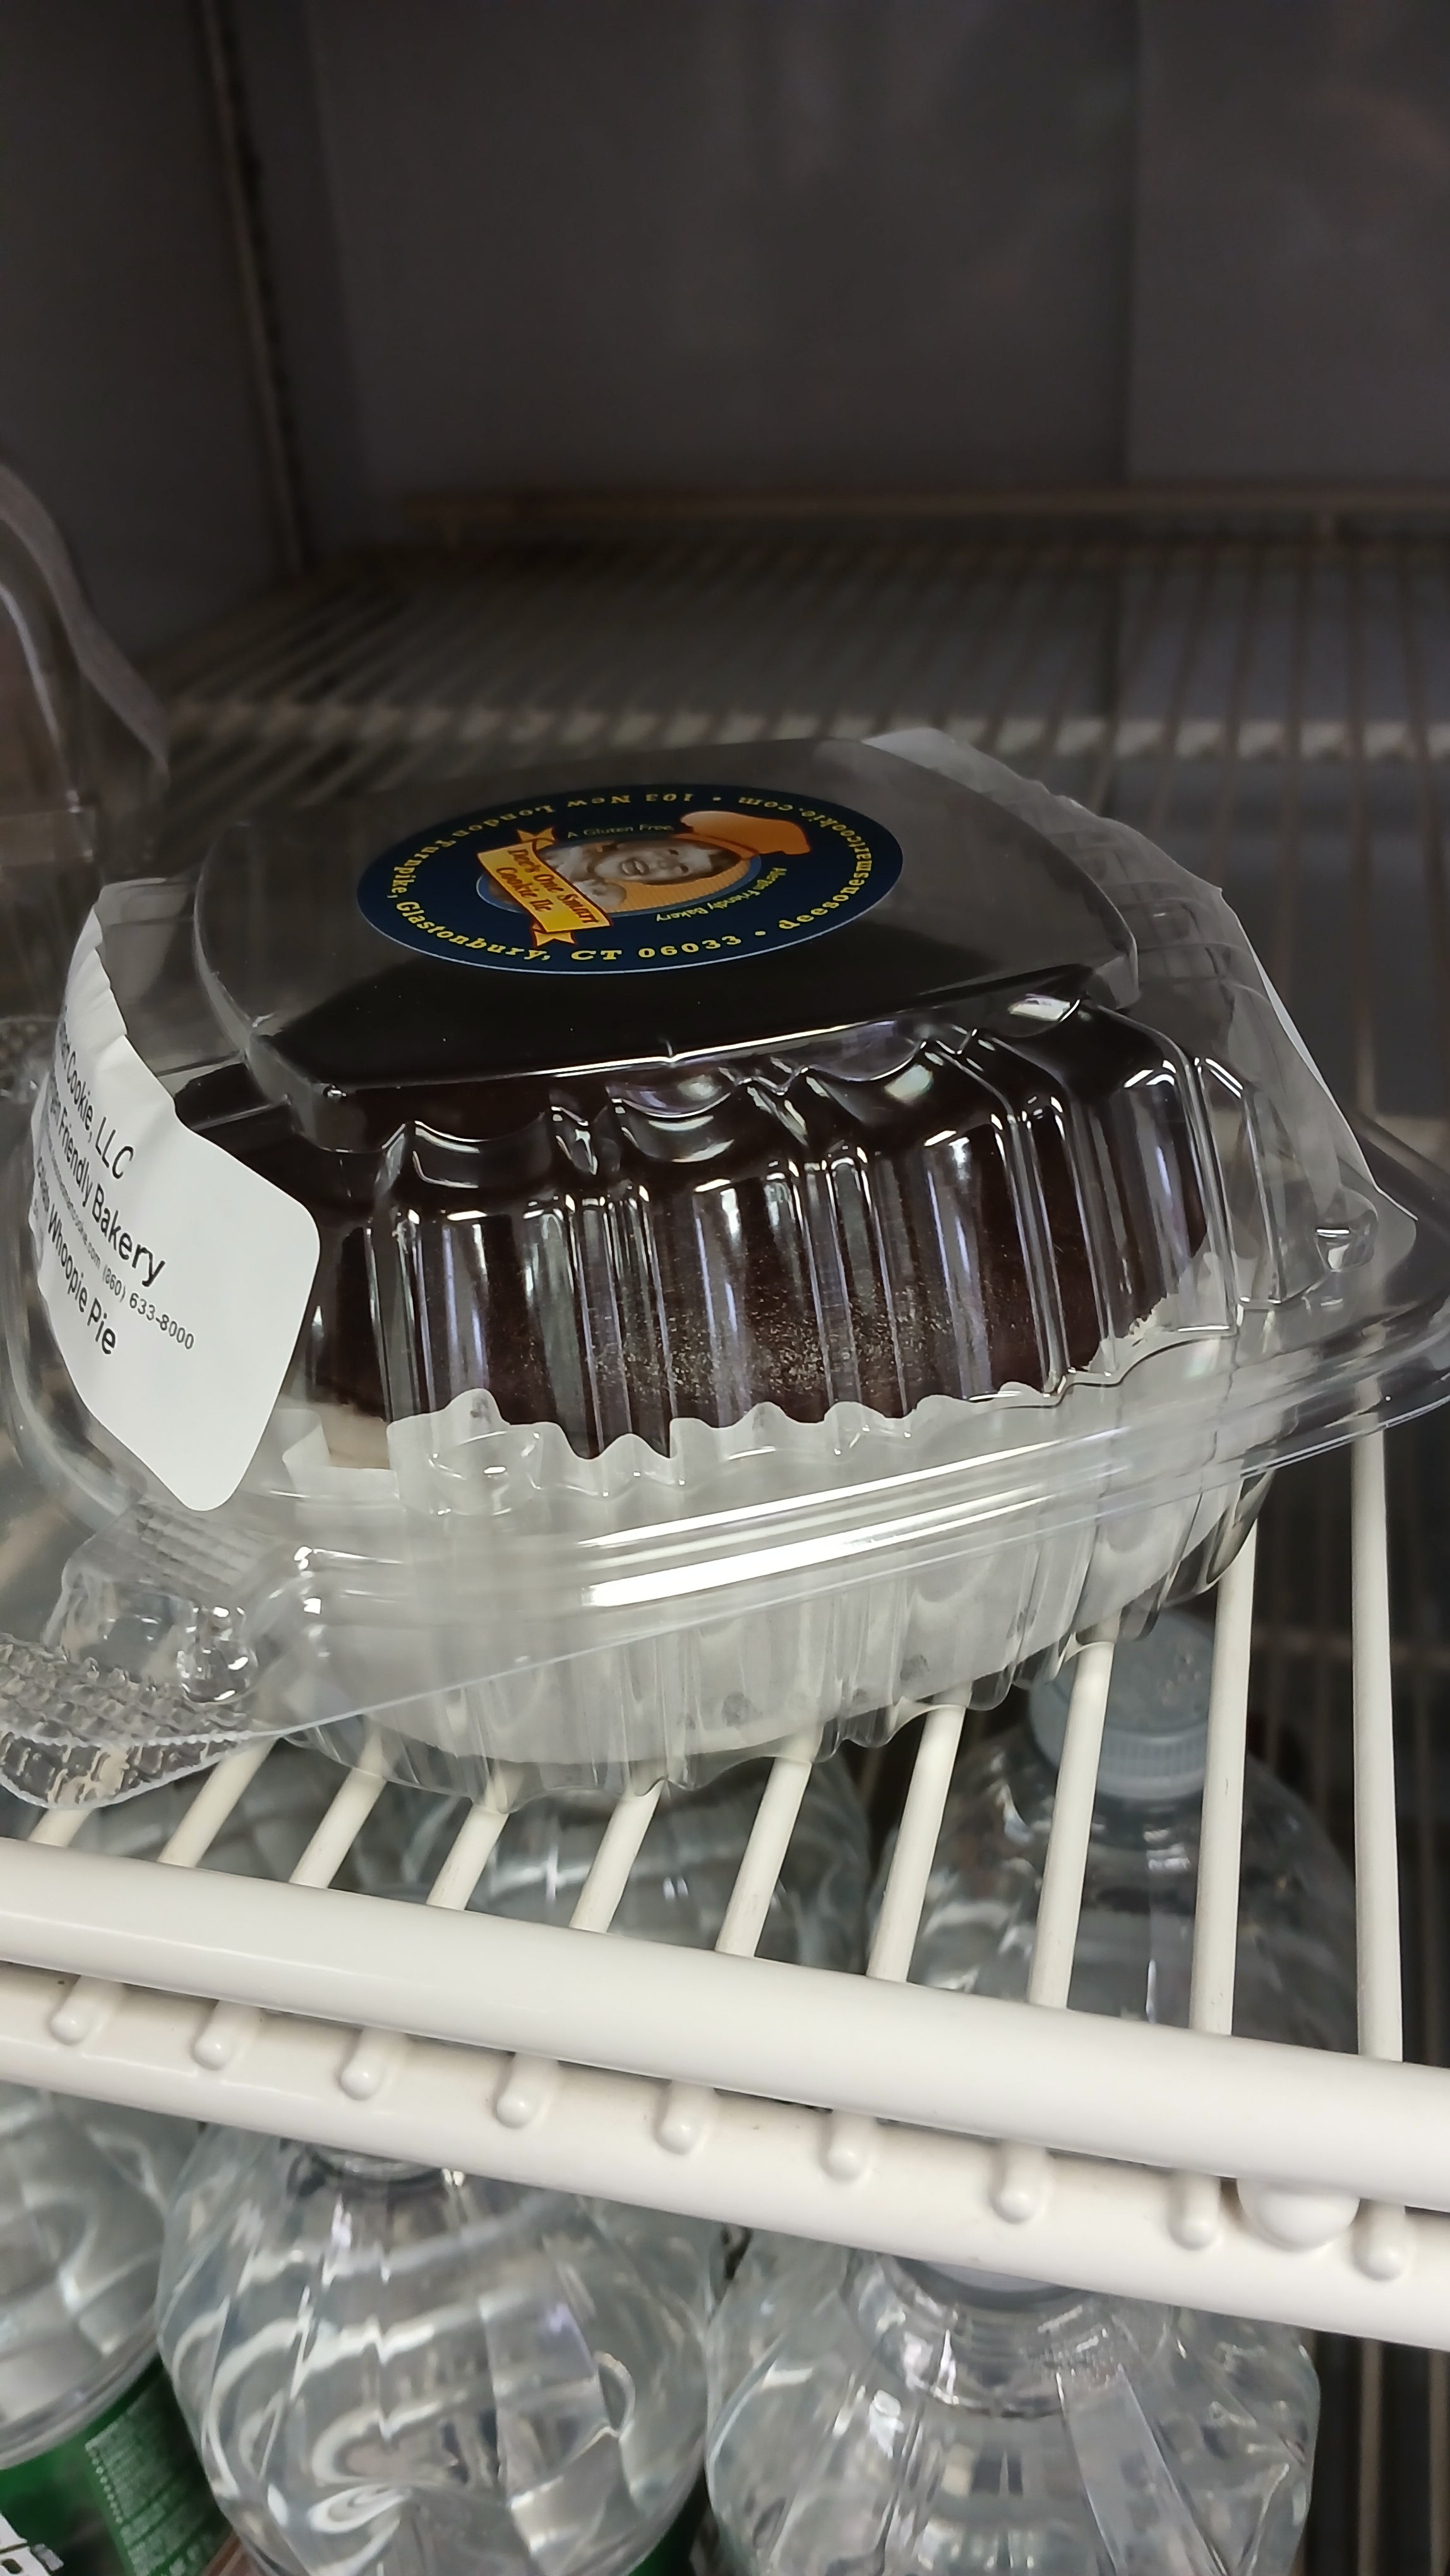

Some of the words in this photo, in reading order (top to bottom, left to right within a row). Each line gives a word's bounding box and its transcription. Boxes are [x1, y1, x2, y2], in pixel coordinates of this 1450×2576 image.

[568, 795, 630, 807] New
[645, 794, 693, 802] 103
[452, 805, 556, 837] London
[583, 826, 633, 835] Gluten
[387, 839, 457, 898] Turnpike,
[496, 867, 539, 898] Cookie
[738, 796, 872, 929] deesonesmartcookie.com
[533, 874, 565, 893] One
[556, 893, 599, 923] Smart
[656, 907, 709, 922] Bakery
[396, 901, 551, 960] Glastonbury,
[638, 936, 741, 958] 06033
[571, 950, 622, 960] CT
[67, 1051, 94, 1143] Cookie,
[95, 1116, 134, 1179] LLC
[58, 1106, 93, 1208] Friendly
[92, 1183, 166, 1287] Bakery
[48, 1203, 90, 1313] Whoopie
[87, 1297, 117, 1356] Pie
[102, 1264, 127, 1303] (860)
[129, 1292, 195, 1351] 633-8000
